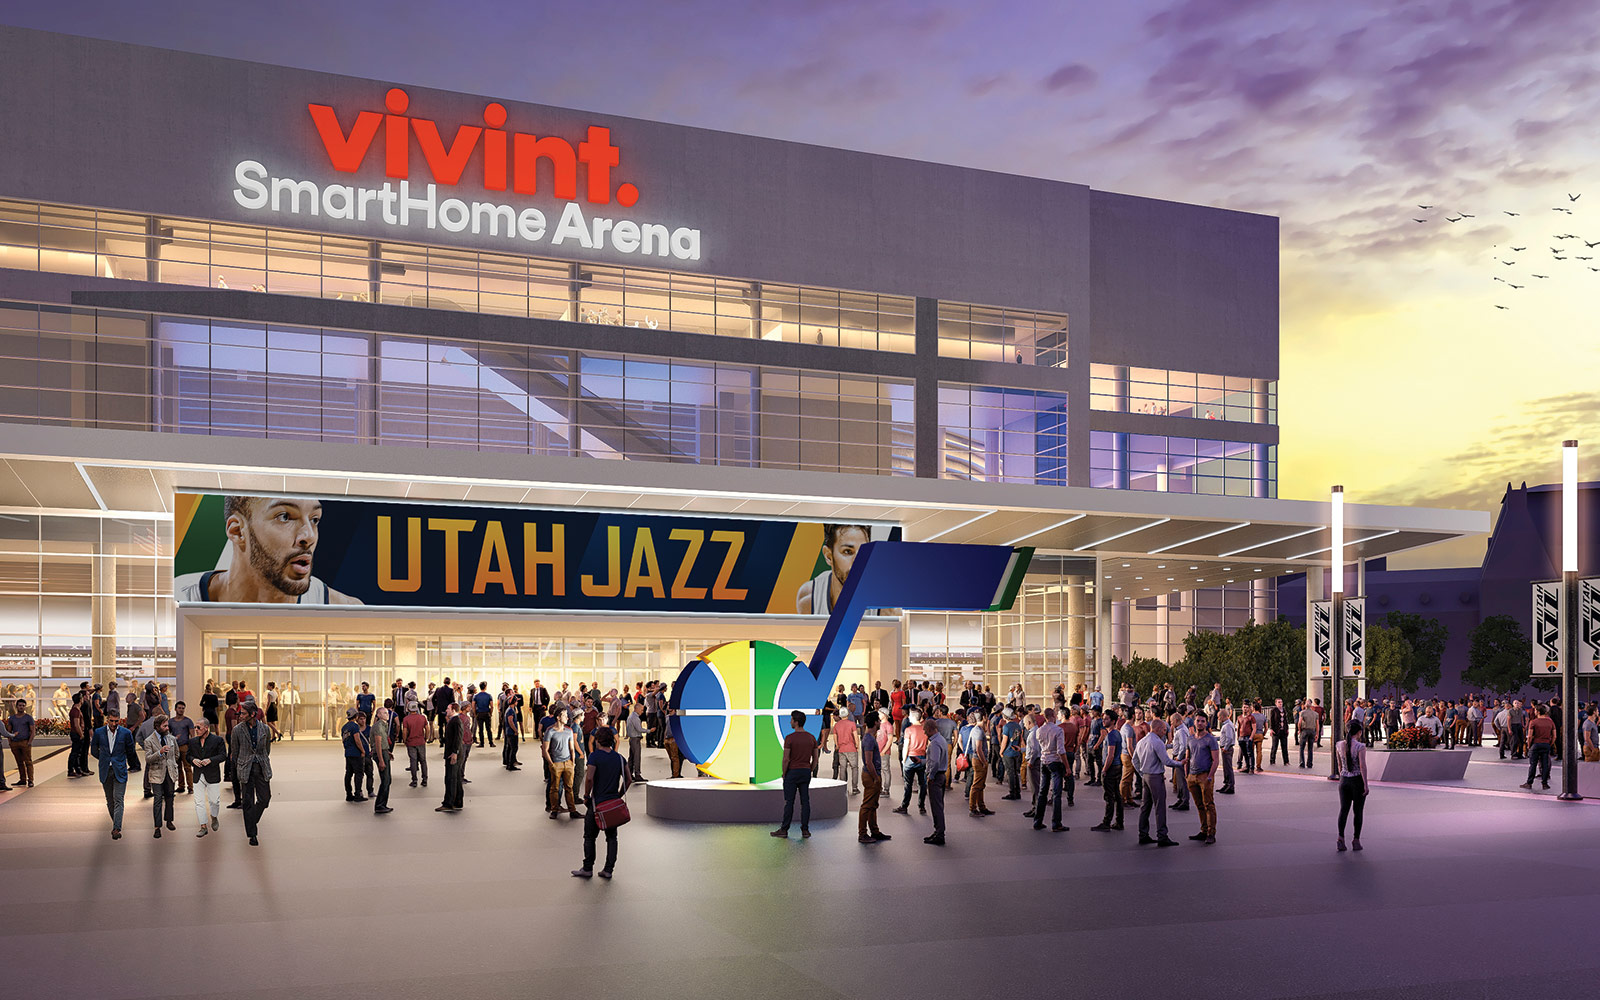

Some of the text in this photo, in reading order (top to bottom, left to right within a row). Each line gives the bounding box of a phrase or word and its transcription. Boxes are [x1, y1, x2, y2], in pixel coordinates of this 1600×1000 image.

[308, 88, 639, 207] vivint.
[233, 160, 701, 260] SmartHome Arena
[376, 515, 749, 601] UTAH JAZZ
[1537, 588, 1558, 672] JAZZ
